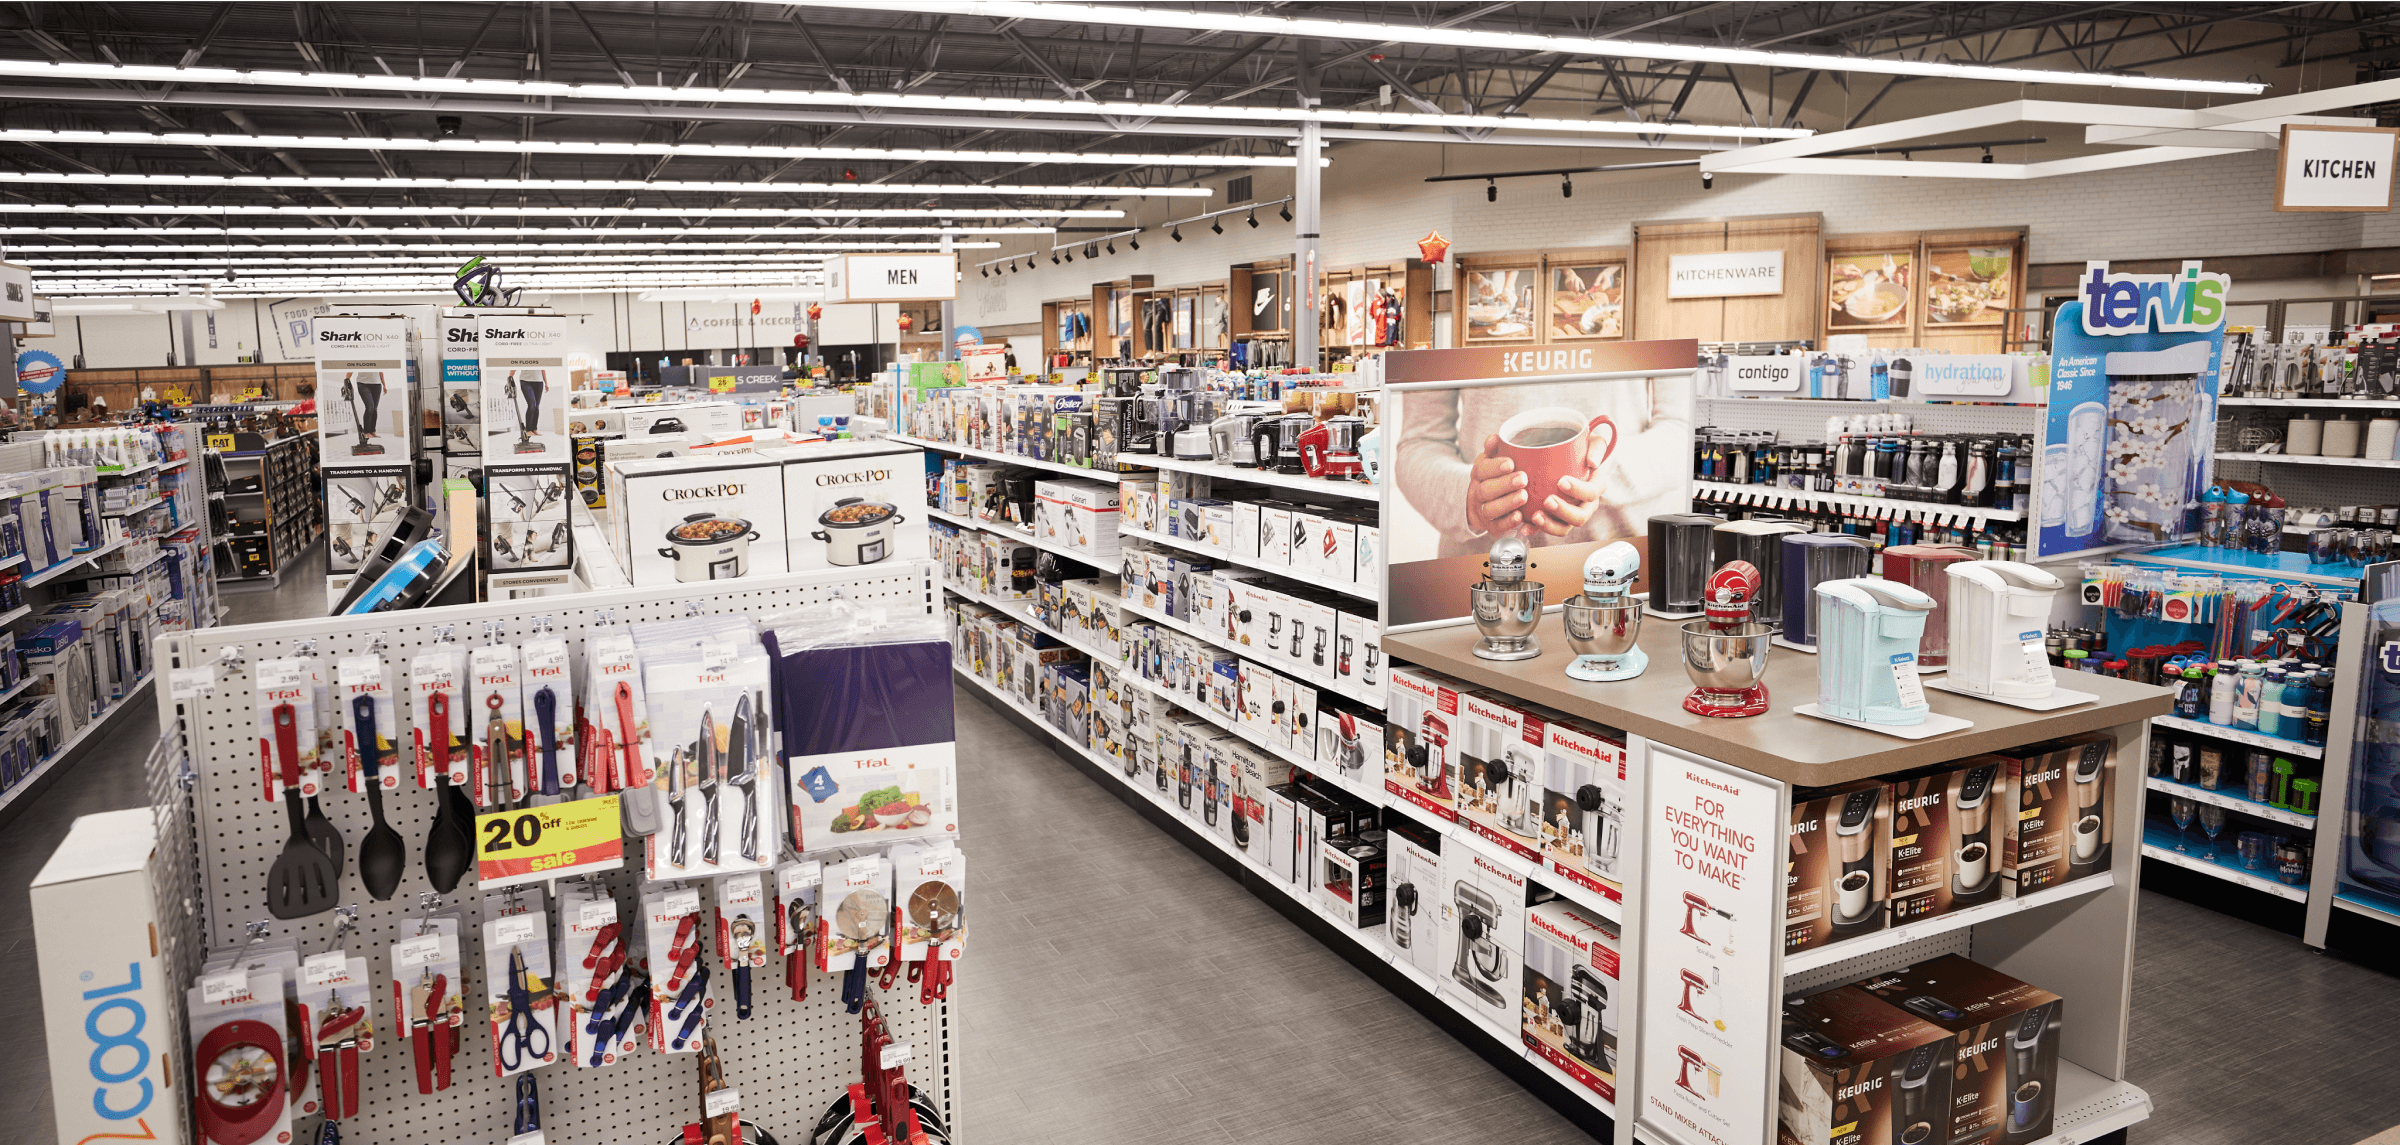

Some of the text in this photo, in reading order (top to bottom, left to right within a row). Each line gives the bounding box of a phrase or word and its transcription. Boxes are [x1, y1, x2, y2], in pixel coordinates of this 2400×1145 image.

[2303, 159, 2376, 179] KITCHEN
[887, 269, 918, 285] MEN
[1675, 265, 1776, 283] KITCHENWARE
[2085, 268, 2224, 329] tervis
[703, 318, 744, 327] COFFEE
[760, 316, 806, 326] ICECREA
[319, 331, 362, 342] Shark
[363, 332, 383, 341] ION
[485, 328, 525, 340] Shark
[526, 330, 546, 339] ION
[1503, 348, 1595, 373] KEURIG
[2058, 356, 2097, 367] An American
[1738, 364, 1792, 383] contigo
[1925, 362, 2003, 383] hydration
[2056, 367, 2096, 379] Classic Since
[2056, 380, 2073, 391] 1946
[1055, 395, 1082, 410] Oster
[212, 438, 230, 448] CAT
[548, 655, 564, 664] 4.99
[617, 654, 634, 662] 4.99
[719, 656, 738, 665] 14.99
[495, 663, 513, 671] 3.99
[281, 675, 299, 684] 2.99
[362, 674, 380, 682] 2.99
[434, 672, 452, 682] 2.99
[1393, 673, 1435, 698] KitchenAid
[1467, 701, 1517, 729] KitchenAid
[1178, 728, 1198, 743] Hamilton
[1204, 741, 1223, 757] Hamilton
[1552, 732, 1612, 764] KitchenAid
[1215, 754, 1229, 767] Beach
[1231, 750, 1256, 769] Hamilton
[814, 775, 824, 785] 4
[1244, 763, 1262, 782] Beach
[2024, 768, 2060, 787] KEURIG
[1686, 771, 1740, 796] KitchenAid
[1695, 795, 1725, 820] FOR
[1899, 793, 1941, 812] KEURIG
[483, 813, 542, 853] 20
[542, 817, 562, 830] off
[1665, 805, 1755, 853] EVERYTHING
[1406, 845, 1437, 868] KitchenAid
[1670, 827, 1748, 871] YOU WANT
[530, 852, 577, 872] sale
[939, 860, 952, 868] 3.99
[1324, 847, 1352, 868] KitchenAid
[1674, 849, 1694, 870] TO
[866, 871, 880, 880] 3.99
[1473, 855, 1523, 888] KitchenAid
[807, 878, 822, 886] 3.49
[746, 889, 761, 897] 3.49
[684, 905, 699, 914] 3.99
[601, 916, 617, 925] 3.99
[517, 932, 533, 941] 2.99
[1531, 912, 1589, 953] KitchenAid
[423, 952, 440, 961] 5.99
[329, 970, 346, 978] 5.99
[1865, 976, 1902, 991] KEURIG
[1675, 1013, 1688, 1024] Fresh
[1687, 1019, 1698, 1031] Prep
[82, 962, 154, 1121] COOL
[1958, 1037, 1998, 1060] KEURIG
[894, 1057, 911, 1066] 19.99
[1838, 1076, 1883, 1101] KEURIG
[721, 1104, 739, 1114] 19.99
[1650, 1095, 1697, 1132] STAND MIXER
[1673, 1088, 1685, 1100] Pasta
[1698, 1103, 1707, 1114] and
[1707, 1109, 1722, 1123] Cutter
[1722, 1118, 1731, 1128] Set
[1837, 1126, 1848, 1134] NEW
